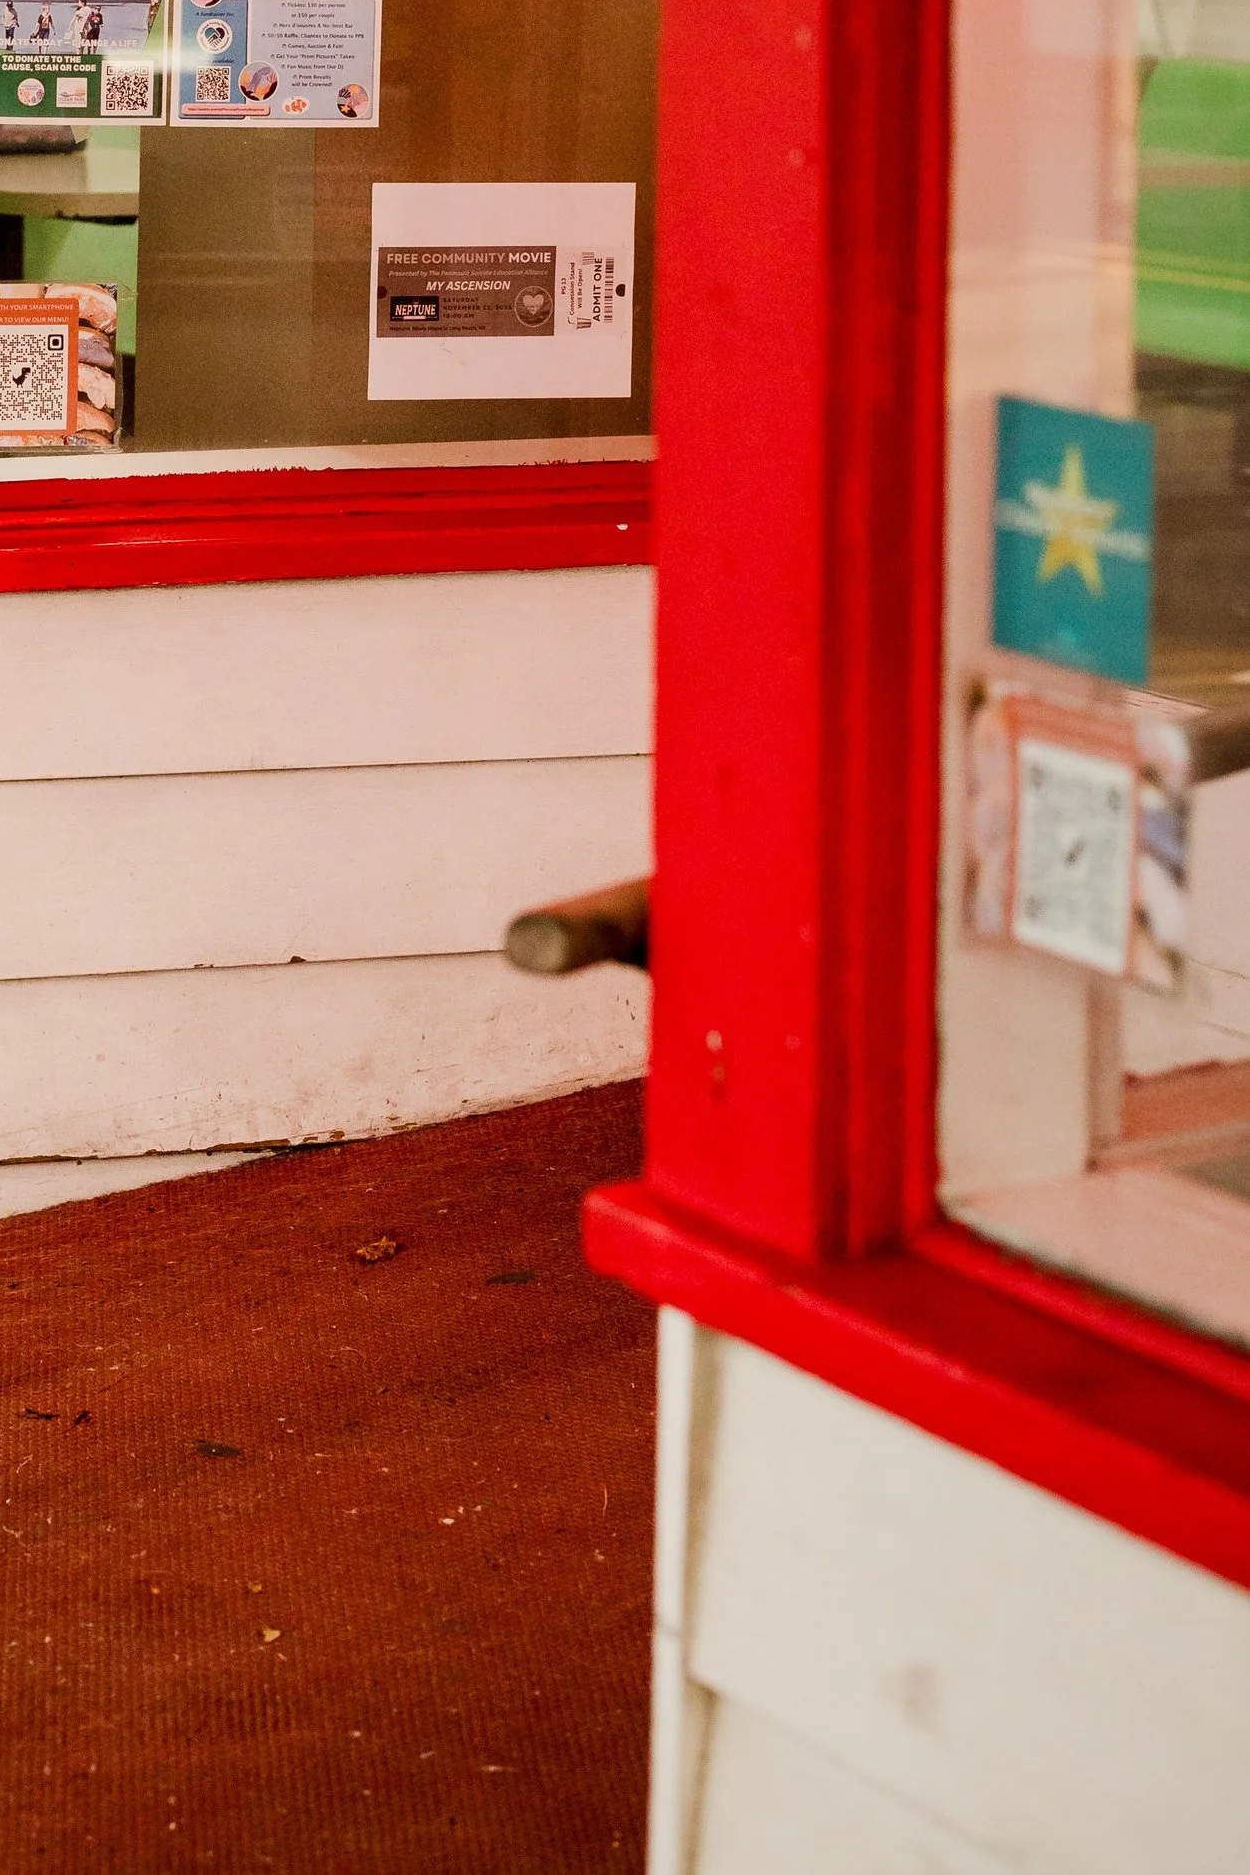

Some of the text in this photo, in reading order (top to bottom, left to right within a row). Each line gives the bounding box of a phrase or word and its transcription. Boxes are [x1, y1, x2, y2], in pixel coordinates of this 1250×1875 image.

[31, 38, 61, 47] TODAY
[72, 38, 108, 47] CHANGE
[109, 39, 118, 47] A
[119, 39, 138, 47] LIFE
[2, 55, 81, 63] TO DONATE TO THE
[1, 63, 96, 72] CAUSE, SCAN QR CODE
[387, 252, 552, 264] FREE COMMUNITY MOVIE
[426, 280, 511, 291] MY ASCENSION
[561, 286, 566, 295] PG
[592, 257, 603, 322] ADMIT ONE
[395, 304, 437, 316] NEPTUNE
